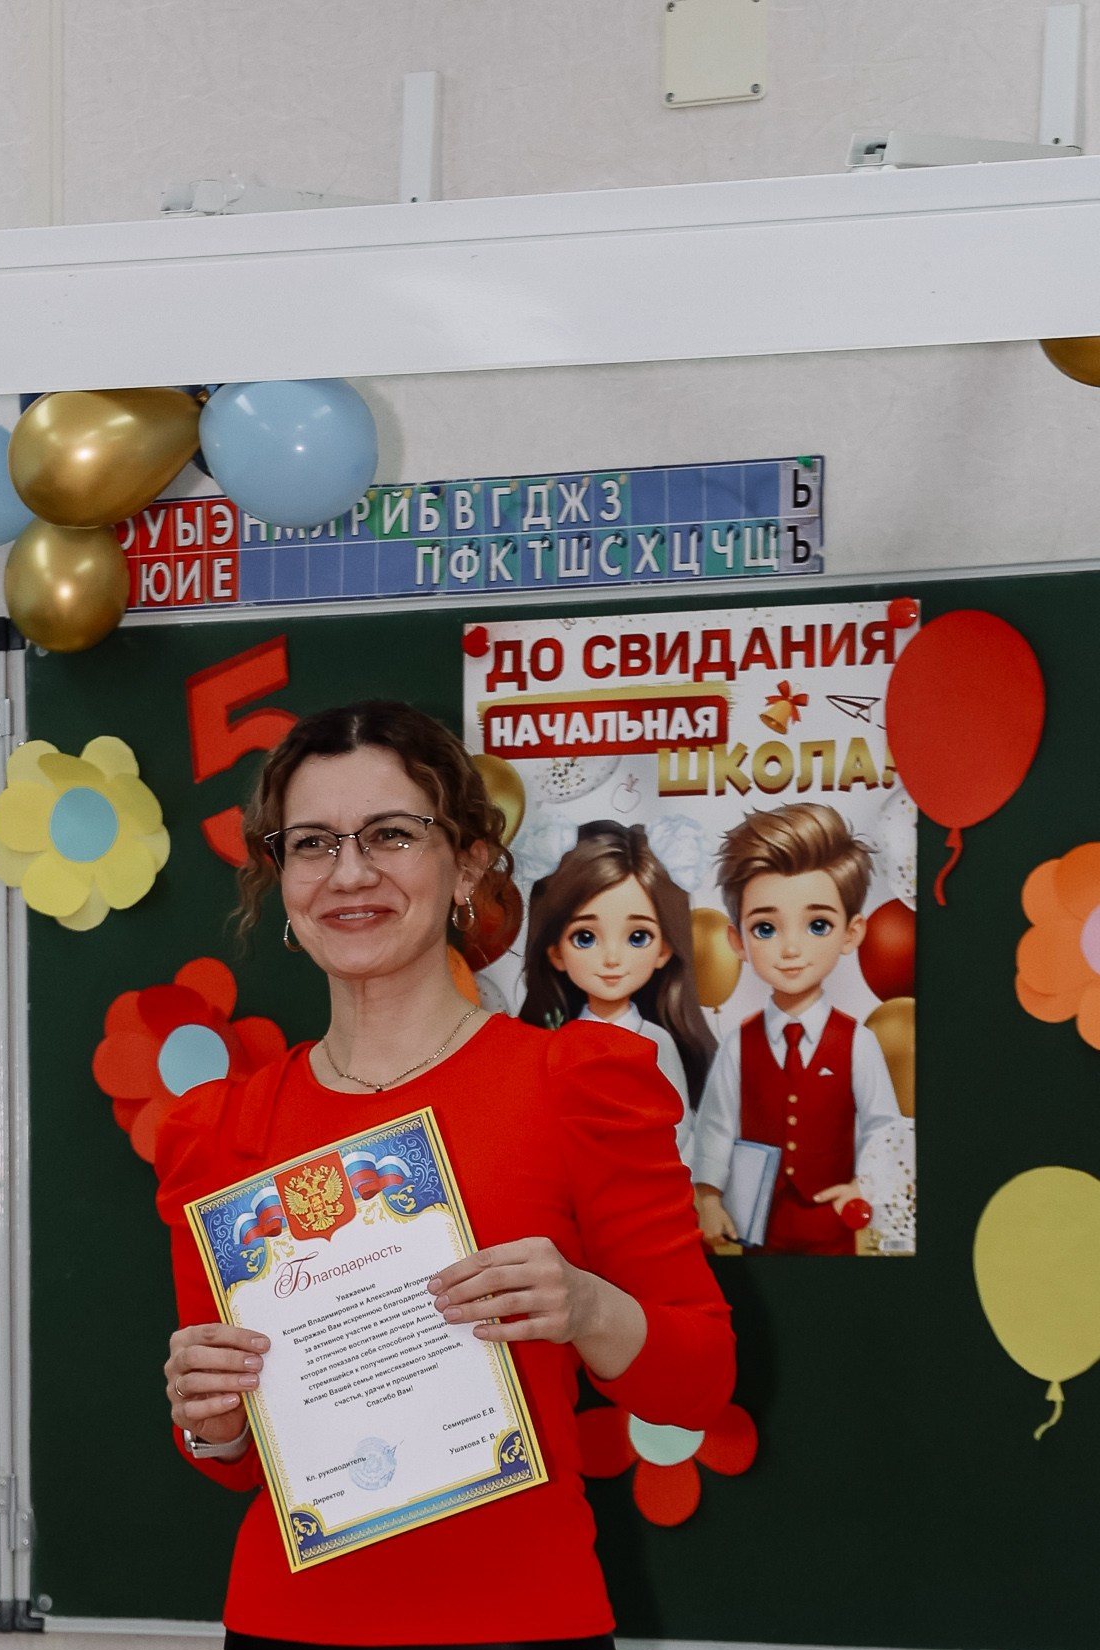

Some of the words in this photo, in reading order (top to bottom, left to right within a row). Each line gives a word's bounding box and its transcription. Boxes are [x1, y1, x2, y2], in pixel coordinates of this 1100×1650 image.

[486, 637, 564, 692] ДО
[582, 621, 896, 683] СВИДАНИЯ
[490, 706, 718, 748] НАЧАЛЬНАЯ
[274, 1244, 403, 1299] Благодарность
